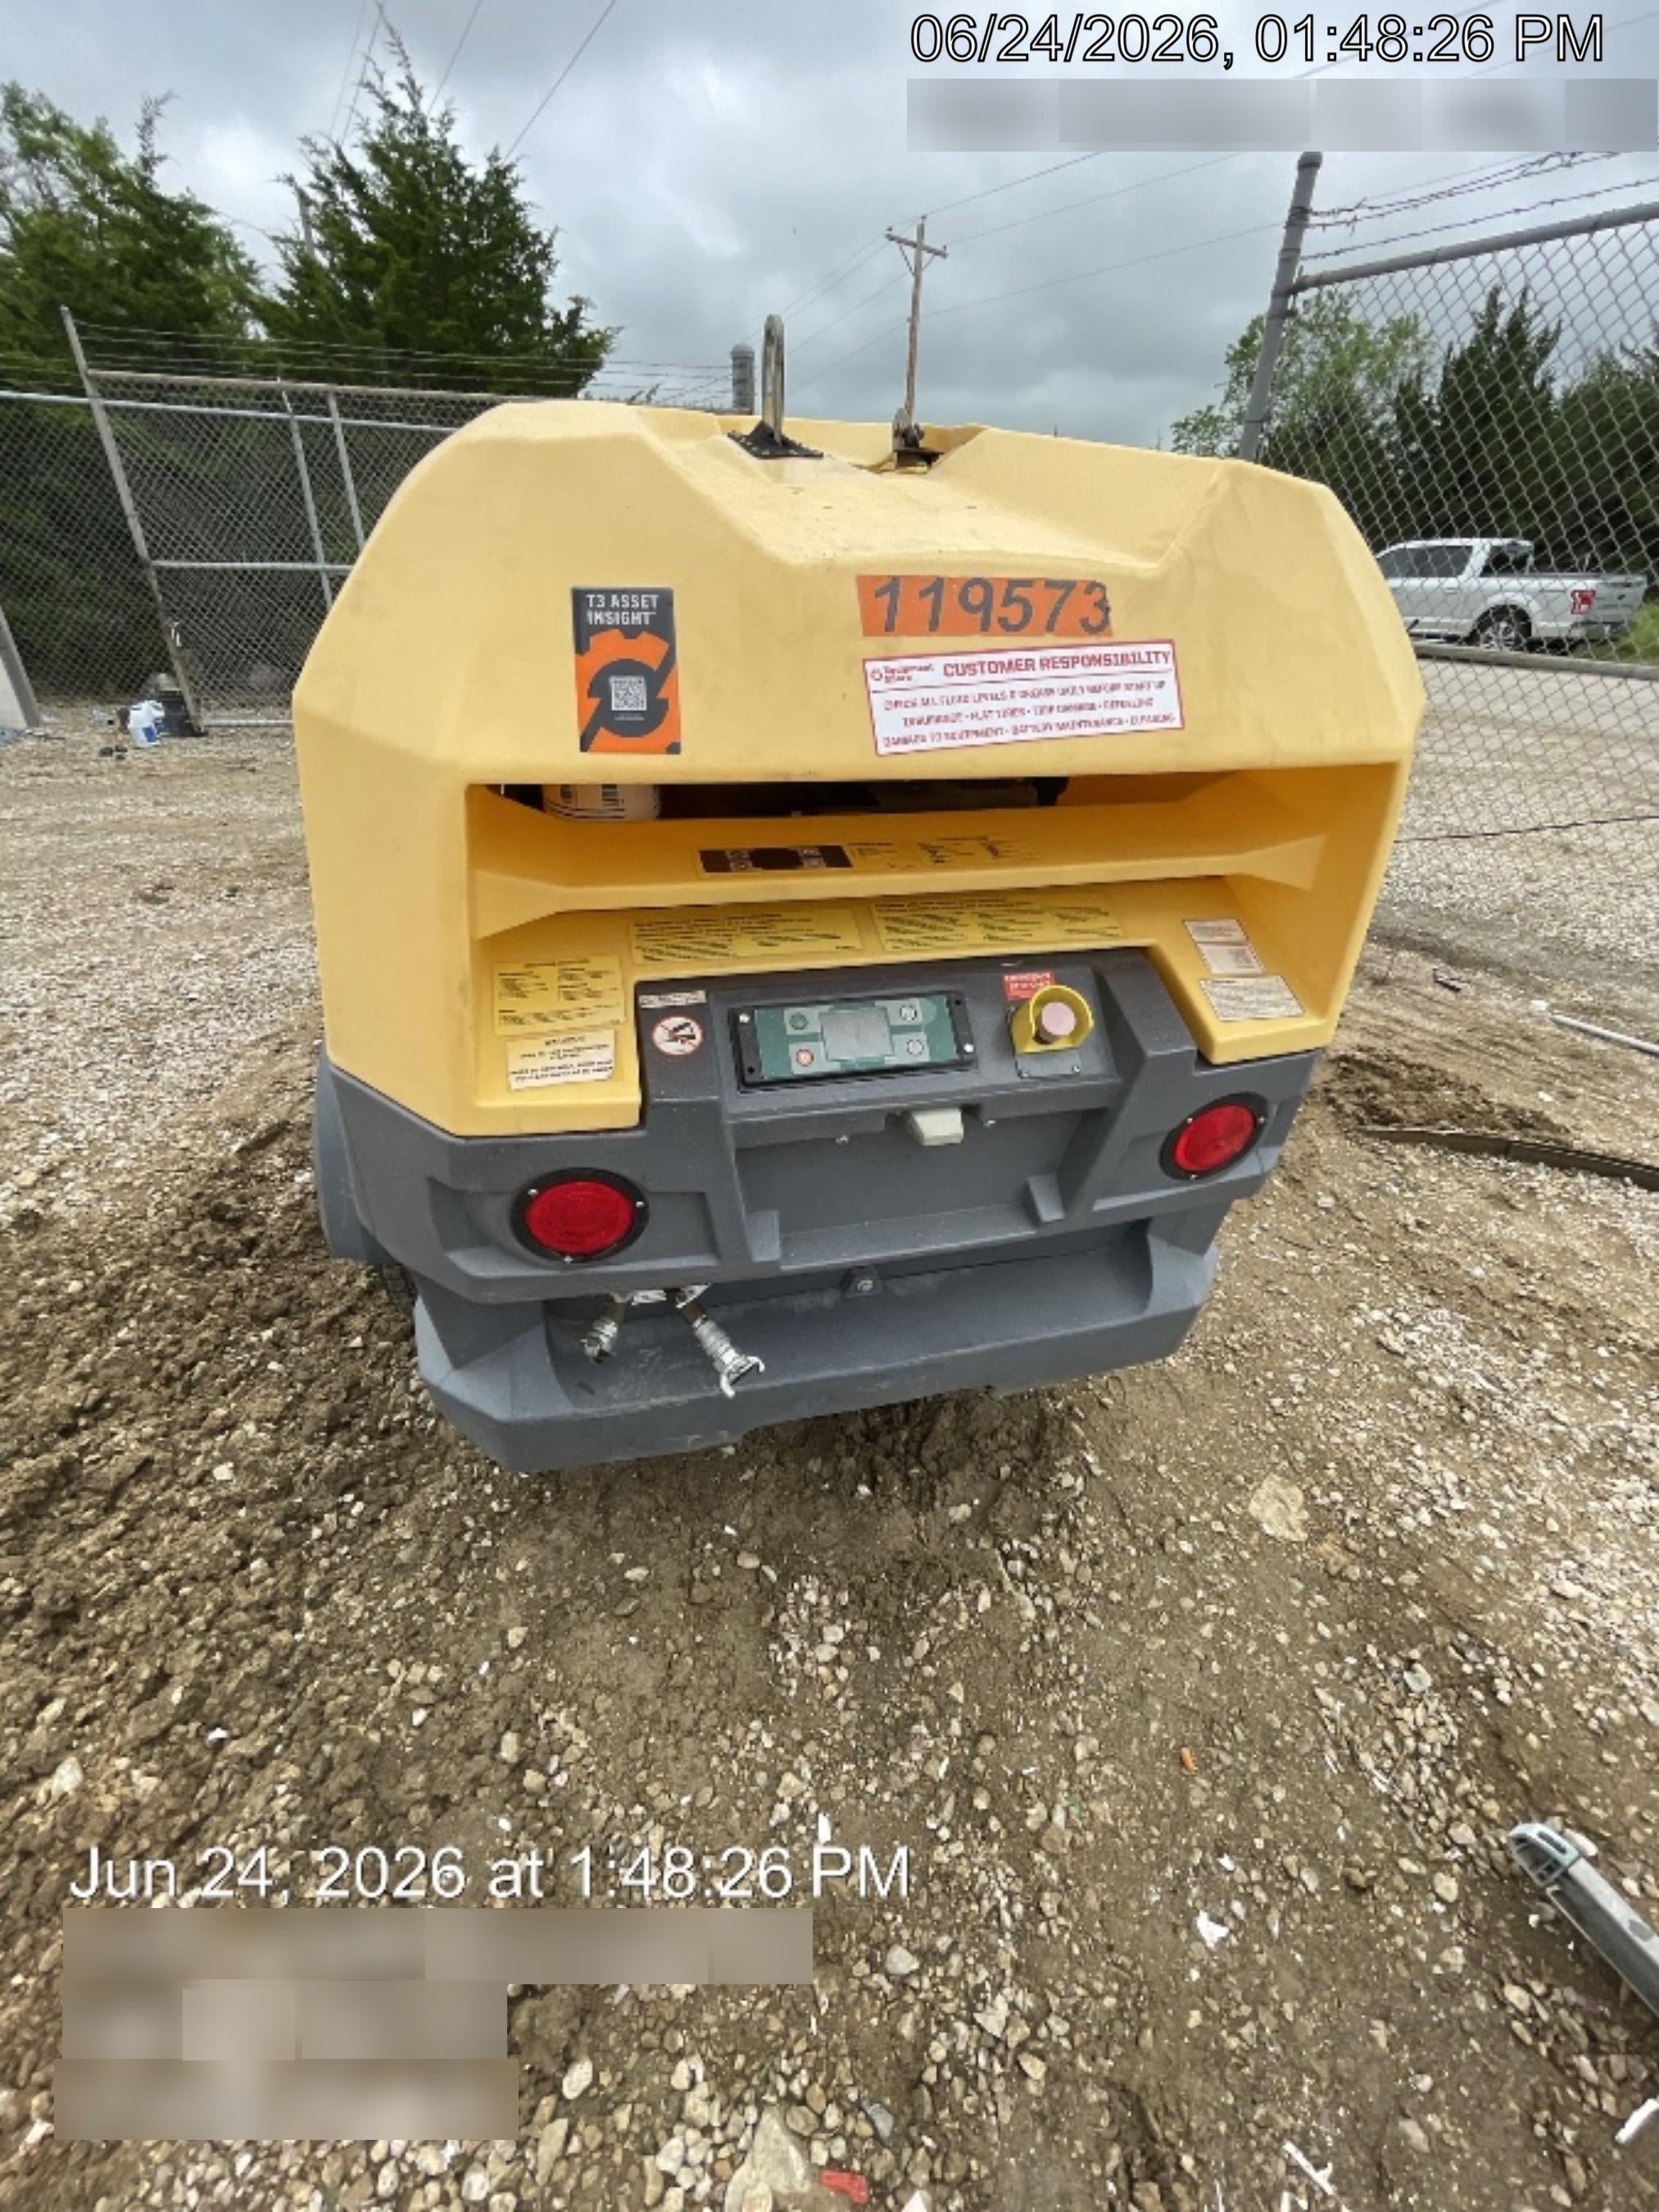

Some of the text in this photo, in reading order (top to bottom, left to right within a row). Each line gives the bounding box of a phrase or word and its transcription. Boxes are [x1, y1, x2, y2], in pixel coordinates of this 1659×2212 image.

[586, 594, 659, 608] T3 ASSET
[874, 576, 1111, 634] 119573
[587, 610, 656, 625] INSIGHT
[943, 650, 1171, 678] CUSTOMER RESPONSIBILITY
